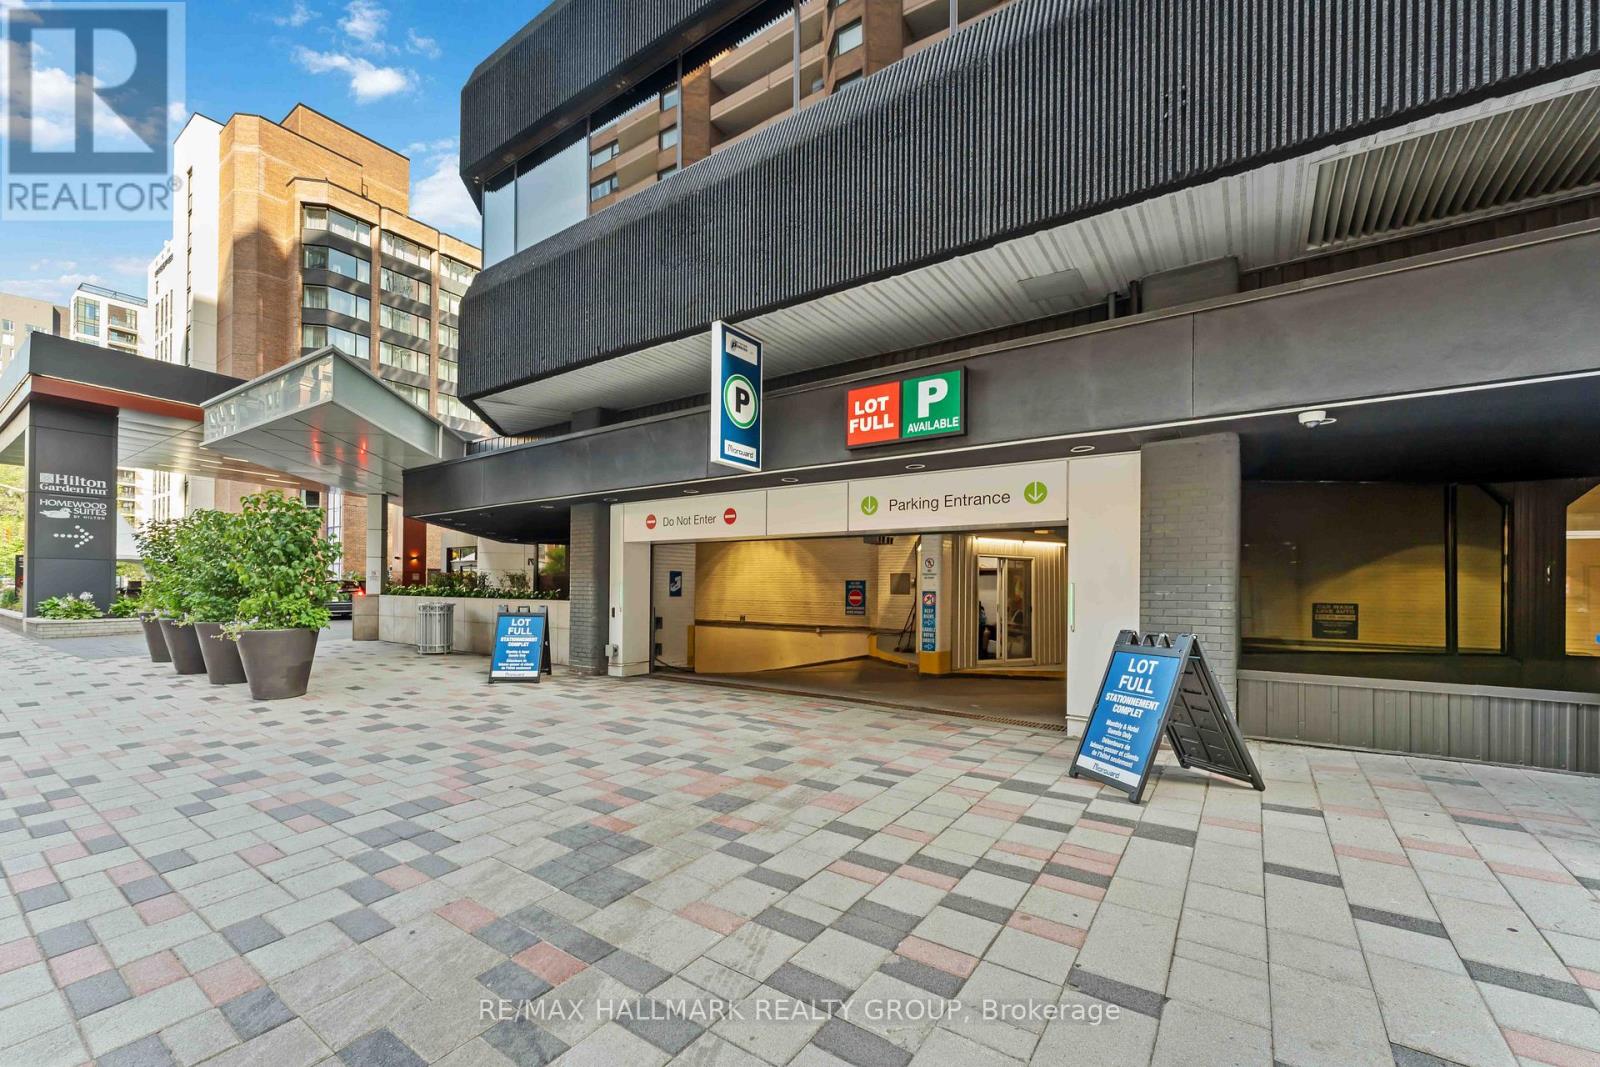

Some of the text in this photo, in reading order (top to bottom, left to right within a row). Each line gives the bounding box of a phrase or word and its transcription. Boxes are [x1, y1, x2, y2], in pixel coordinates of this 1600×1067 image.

[735, 386, 750, 413] P
[854, 396, 889, 414] LOT
[917, 378, 948, 419] P
[850, 415, 894, 433] FULL
[907, 416, 959, 433] AVAILABLE
[40, 482, 107, 496] Garden Inn
[55, 473, 107, 489] Hilton
[40, 498, 107, 510] HOMEWOOD
[889, 492, 1011, 512] Parking Entrance
[73, 507, 107, 516] SUITES
[662, 514, 717, 527] Do Not Enter
[511, 618, 531, 626] LOT
[508, 627, 532, 635] FULL
[1128, 658, 1159, 675] LOT
[1119, 675, 1154, 694] FULL
[1105, 692, 1160, 710] STATIONNEMENT
[1112, 704, 1144, 718] COMPLET
